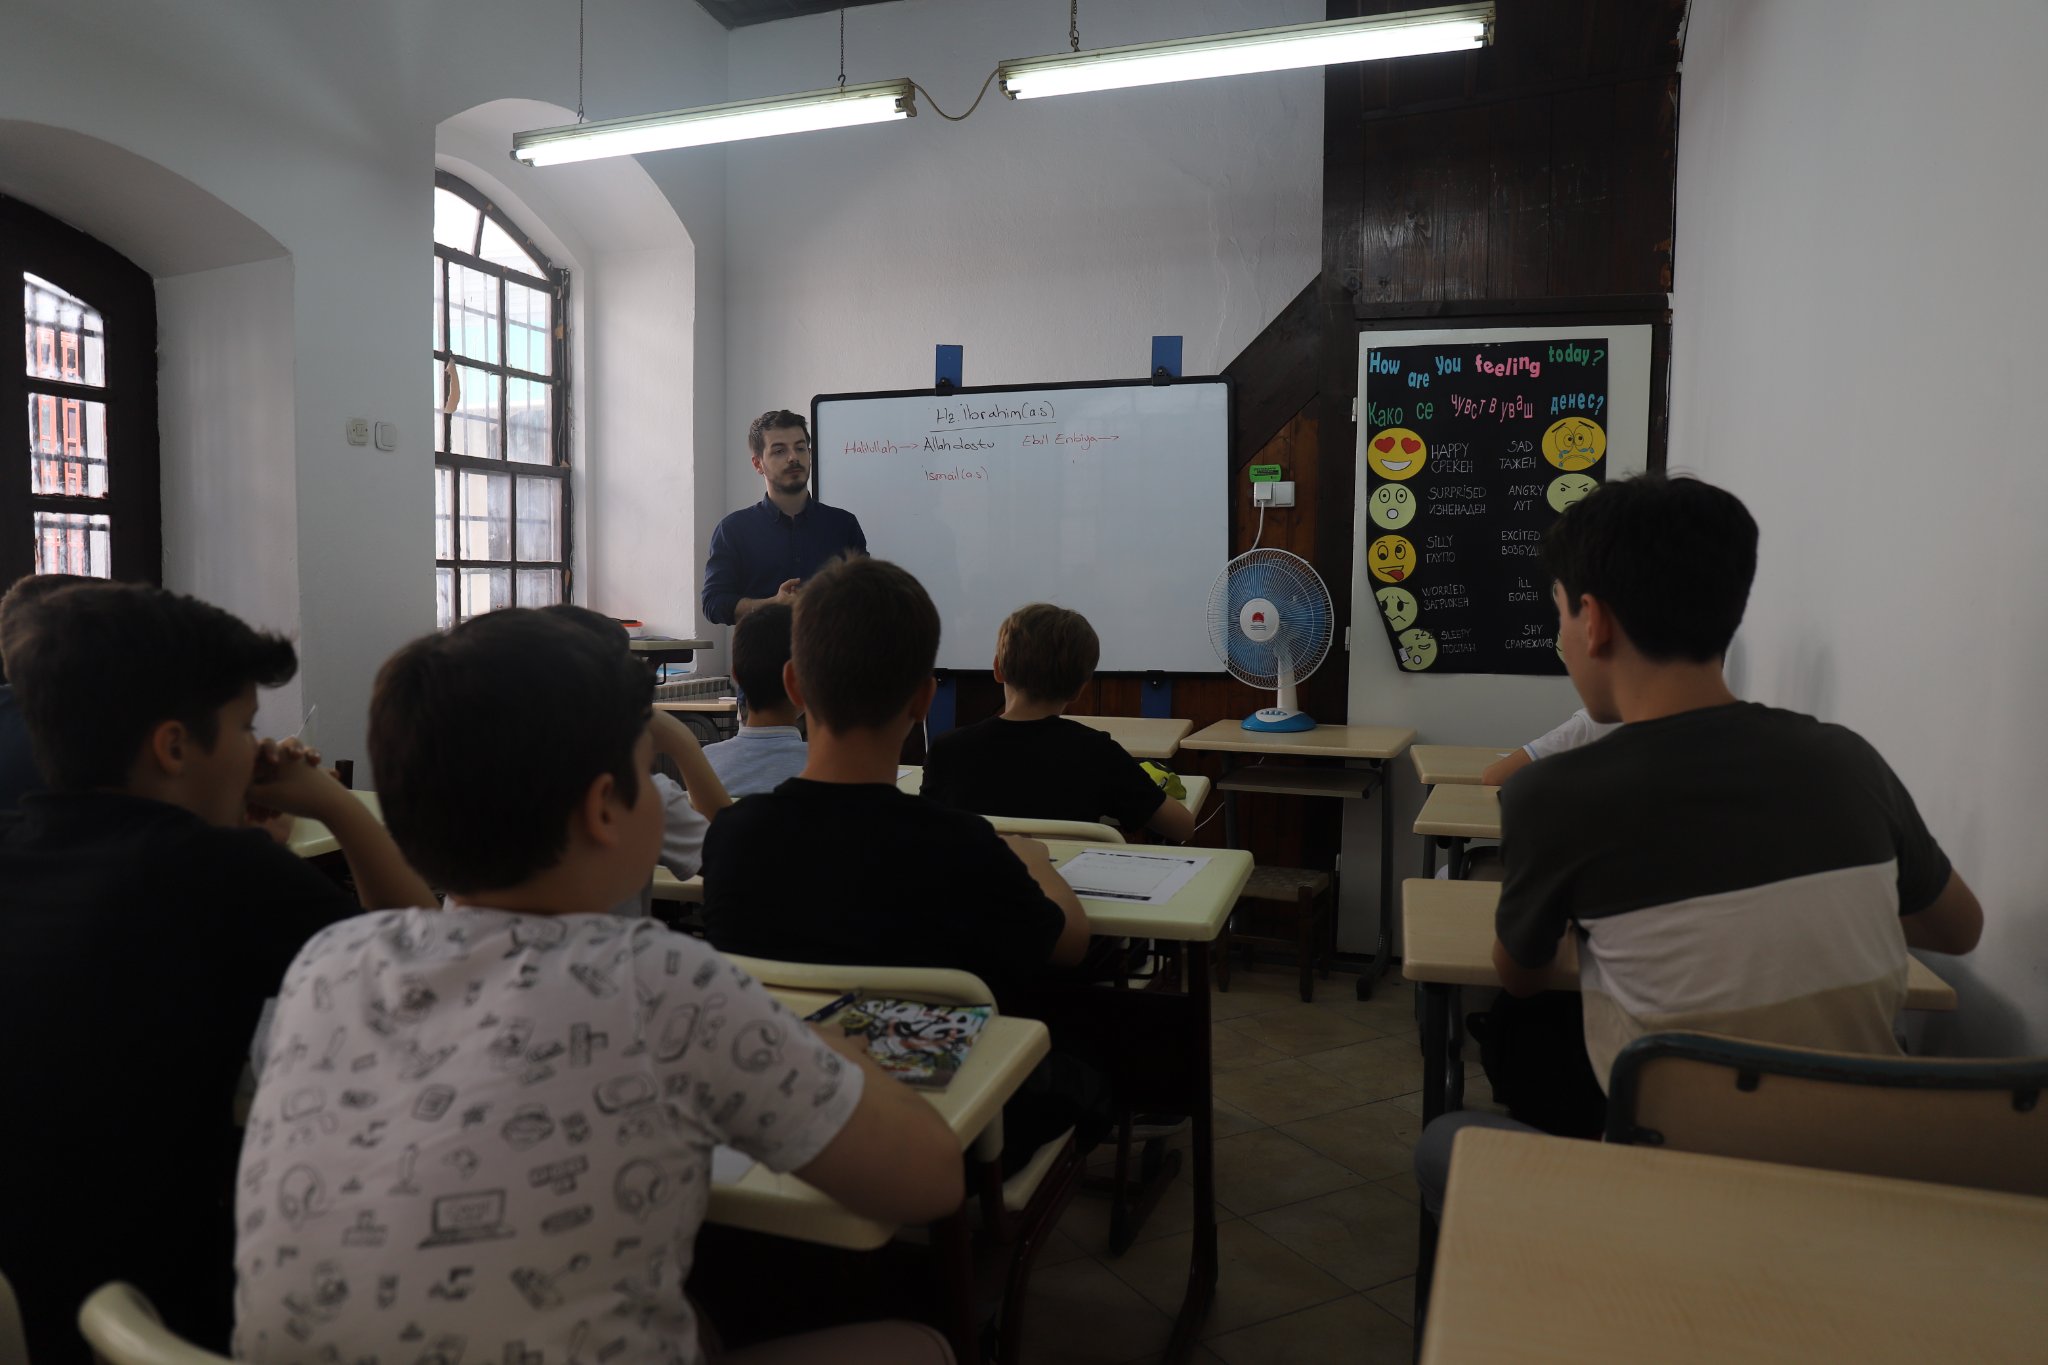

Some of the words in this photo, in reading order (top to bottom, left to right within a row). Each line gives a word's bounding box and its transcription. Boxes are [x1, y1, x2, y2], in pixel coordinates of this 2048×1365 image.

[1369, 352, 1400, 375] How
[1408, 370, 1430, 389] are
[1435, 355, 1461, 375] you
[1475, 354, 1541, 378] feeling
[1367, 402, 1404, 426] Како
[1416, 402, 1434, 420] се
[1550, 392, 1604, 416] денес?
[1431, 442, 1470, 460] HAPPY
[1507, 440, 1534, 453] SAD
[1508, 484, 1545, 497] ANGRY
[1522, 624, 1544, 636] SHY
